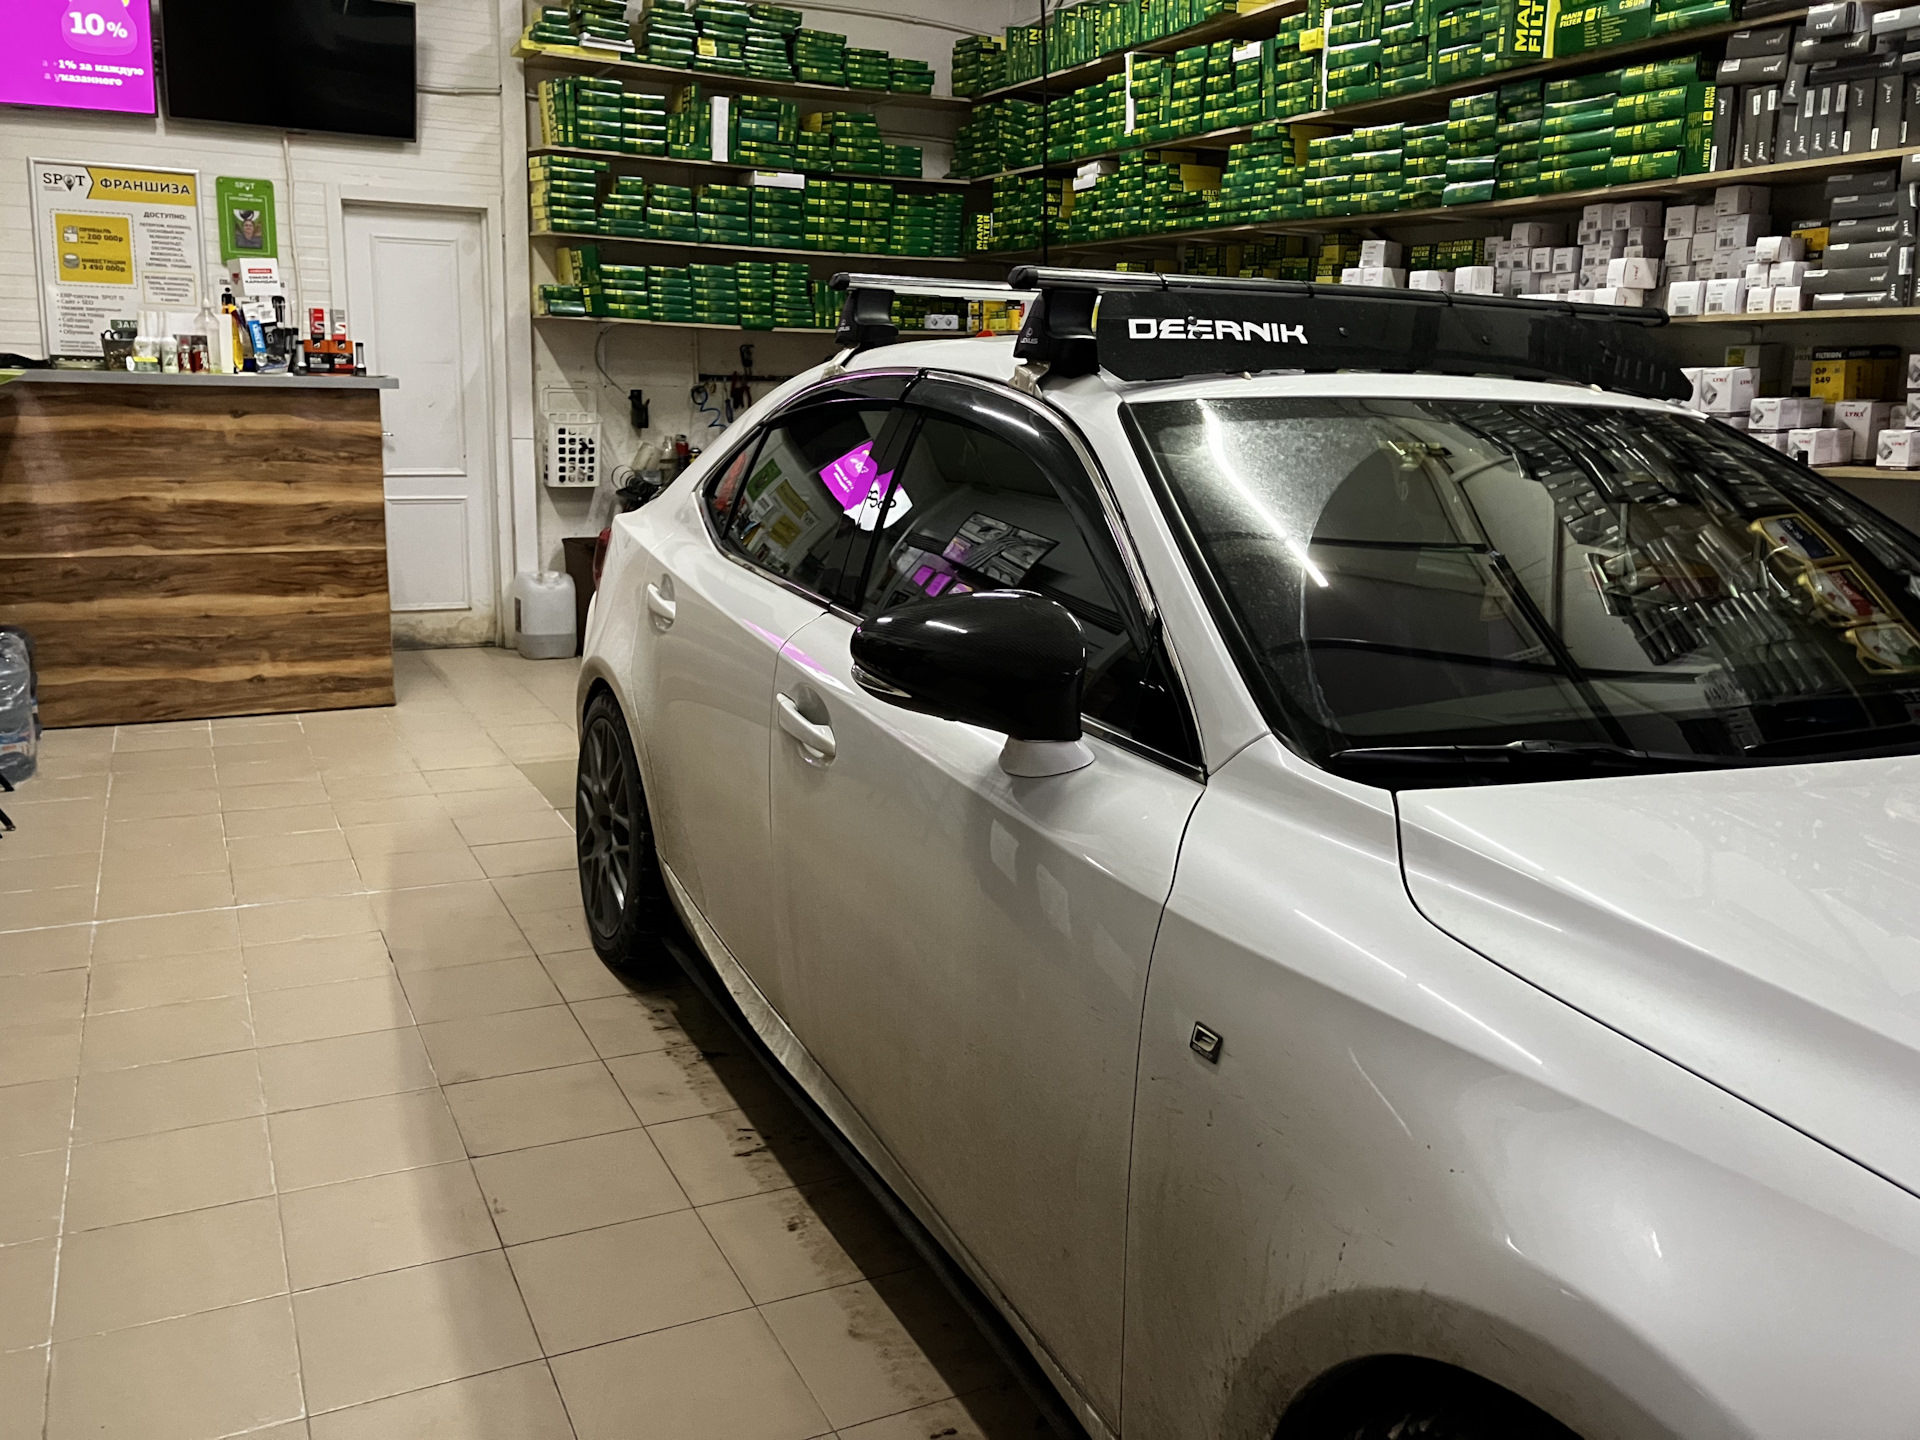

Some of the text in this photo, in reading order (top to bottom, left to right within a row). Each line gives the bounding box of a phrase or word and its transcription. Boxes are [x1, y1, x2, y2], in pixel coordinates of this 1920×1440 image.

[1561, 11, 1583, 21] MANN
[69, 12, 128, 38] 10%
[1560, 18, 1582, 28] FILTER
[1816, 16, 1836, 30] LYNX
[1844, 37, 1863, 49] LYNX
[1763, 62, 1781, 73] LYNX
[1884, 84, 1892, 103] LYNX
[1829, 131, 1838, 149] LYNX
[43, 173, 85, 190] SPOT
[100, 178, 191, 195] ФРАНШИЗА
[143, 212, 186, 220] ДОСТУПНО:
[976, 215, 984, 250] MANN
[1877, 223, 1898, 233] LYNX
[1904, 220, 1912, 237] LYNX
[1870, 249, 1890, 259] LYNX
[1870, 273, 1887, 281] LYNX
[1128, 318, 1308, 344] DEERNIK
[1713, 374, 1729, 383] LYNX
[1845, 408, 1867, 417] LYNX
